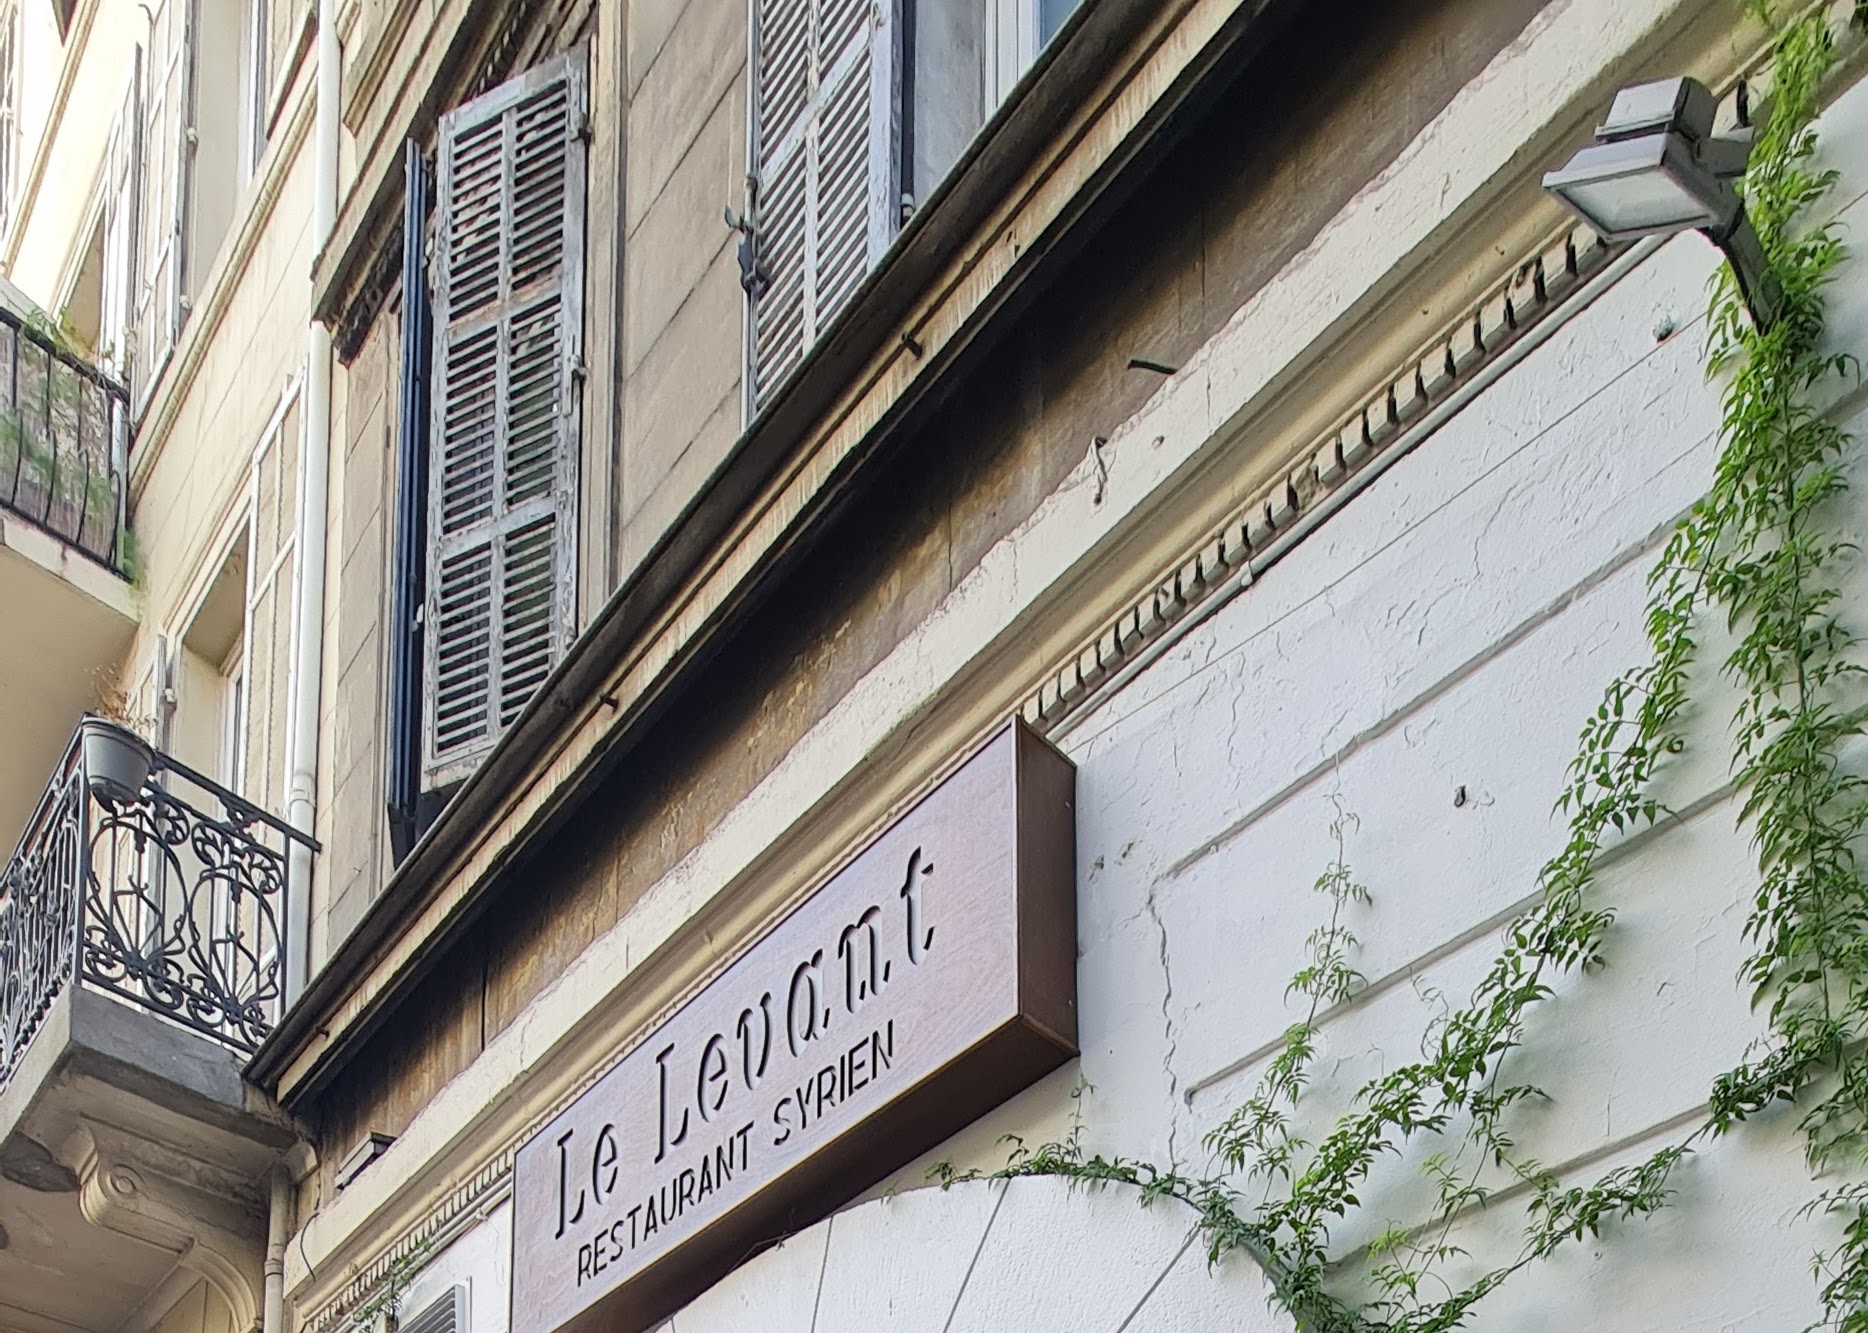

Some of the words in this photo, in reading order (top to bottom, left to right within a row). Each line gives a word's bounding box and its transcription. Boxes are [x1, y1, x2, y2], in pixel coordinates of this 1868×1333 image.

[554, 1122, 619, 1240] Le
[654, 845, 935, 1164] Levant
[576, 1120, 754, 1288] RESTAURANT
[773, 1019, 895, 1147] SYRIEN
